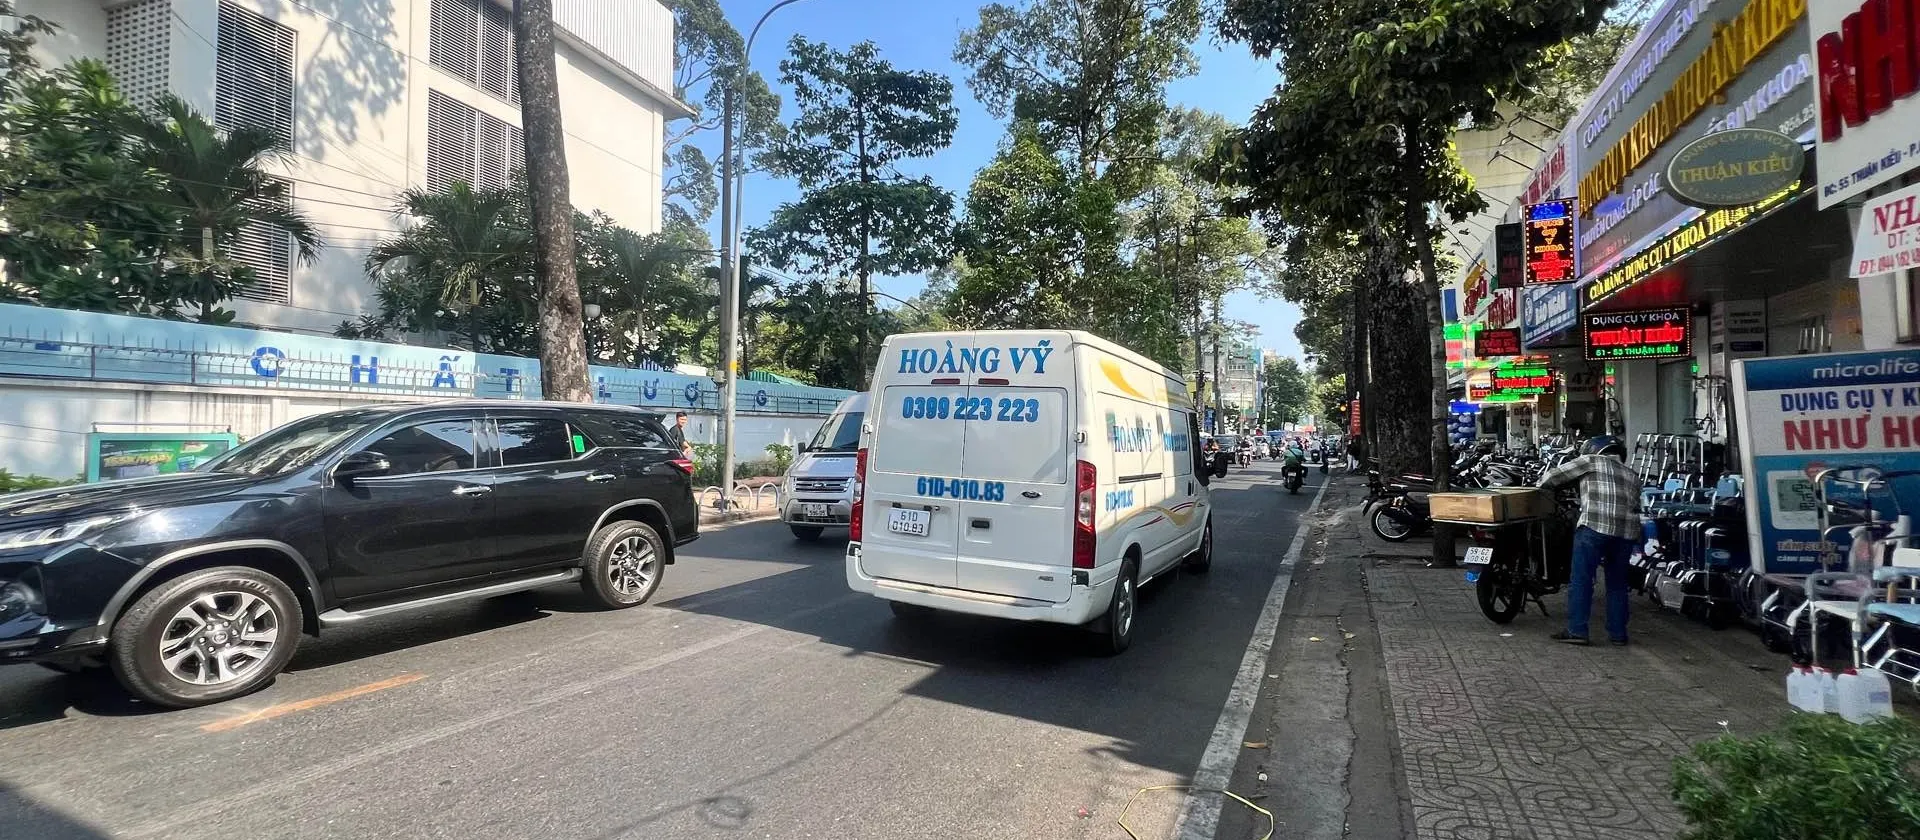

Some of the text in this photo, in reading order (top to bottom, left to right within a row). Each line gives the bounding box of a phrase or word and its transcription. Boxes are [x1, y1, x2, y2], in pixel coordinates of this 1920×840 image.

[1756, 53, 1810, 113] KHOA
[1816, 0, 1920, 142] NH
[1608, 92, 1620, 120] TY
[1620, 52, 1652, 104] TNHH
[1577, 162, 1603, 219] DỤNG
[1630, 100, 1670, 169] KHOA
[1678, 151, 1795, 183] THUẬN KIỀU
[1850, 162, 1879, 186] THUẬN
[1872, 195, 1920, 235] NH
[1673, 222, 1707, 254] KHOA
[1592, 312, 1679, 326] DỤNG CỤ Y KHOA
[1590, 326, 1643, 347] THUẬN
[1625, 345, 1655, 355] THUẬN
[1656, 343, 1679, 354] KIỀU
[898, 340, 1054, 375] HOÀNG VỸ
[1813, 357, 1920, 379] microlife
[902, 396, 1040, 423] 0399 223 223
[1780, 391, 1839, 415] DỤNG
[1845, 389, 1874, 413] CỤ
[1882, 388, 1894, 407] Y
[1783, 414, 1871, 450] NHƯ
[917, 476, 1005, 502] 61D-010.83
[892, 521, 924, 534] 010.83
[900, 511, 918, 522] 61D
